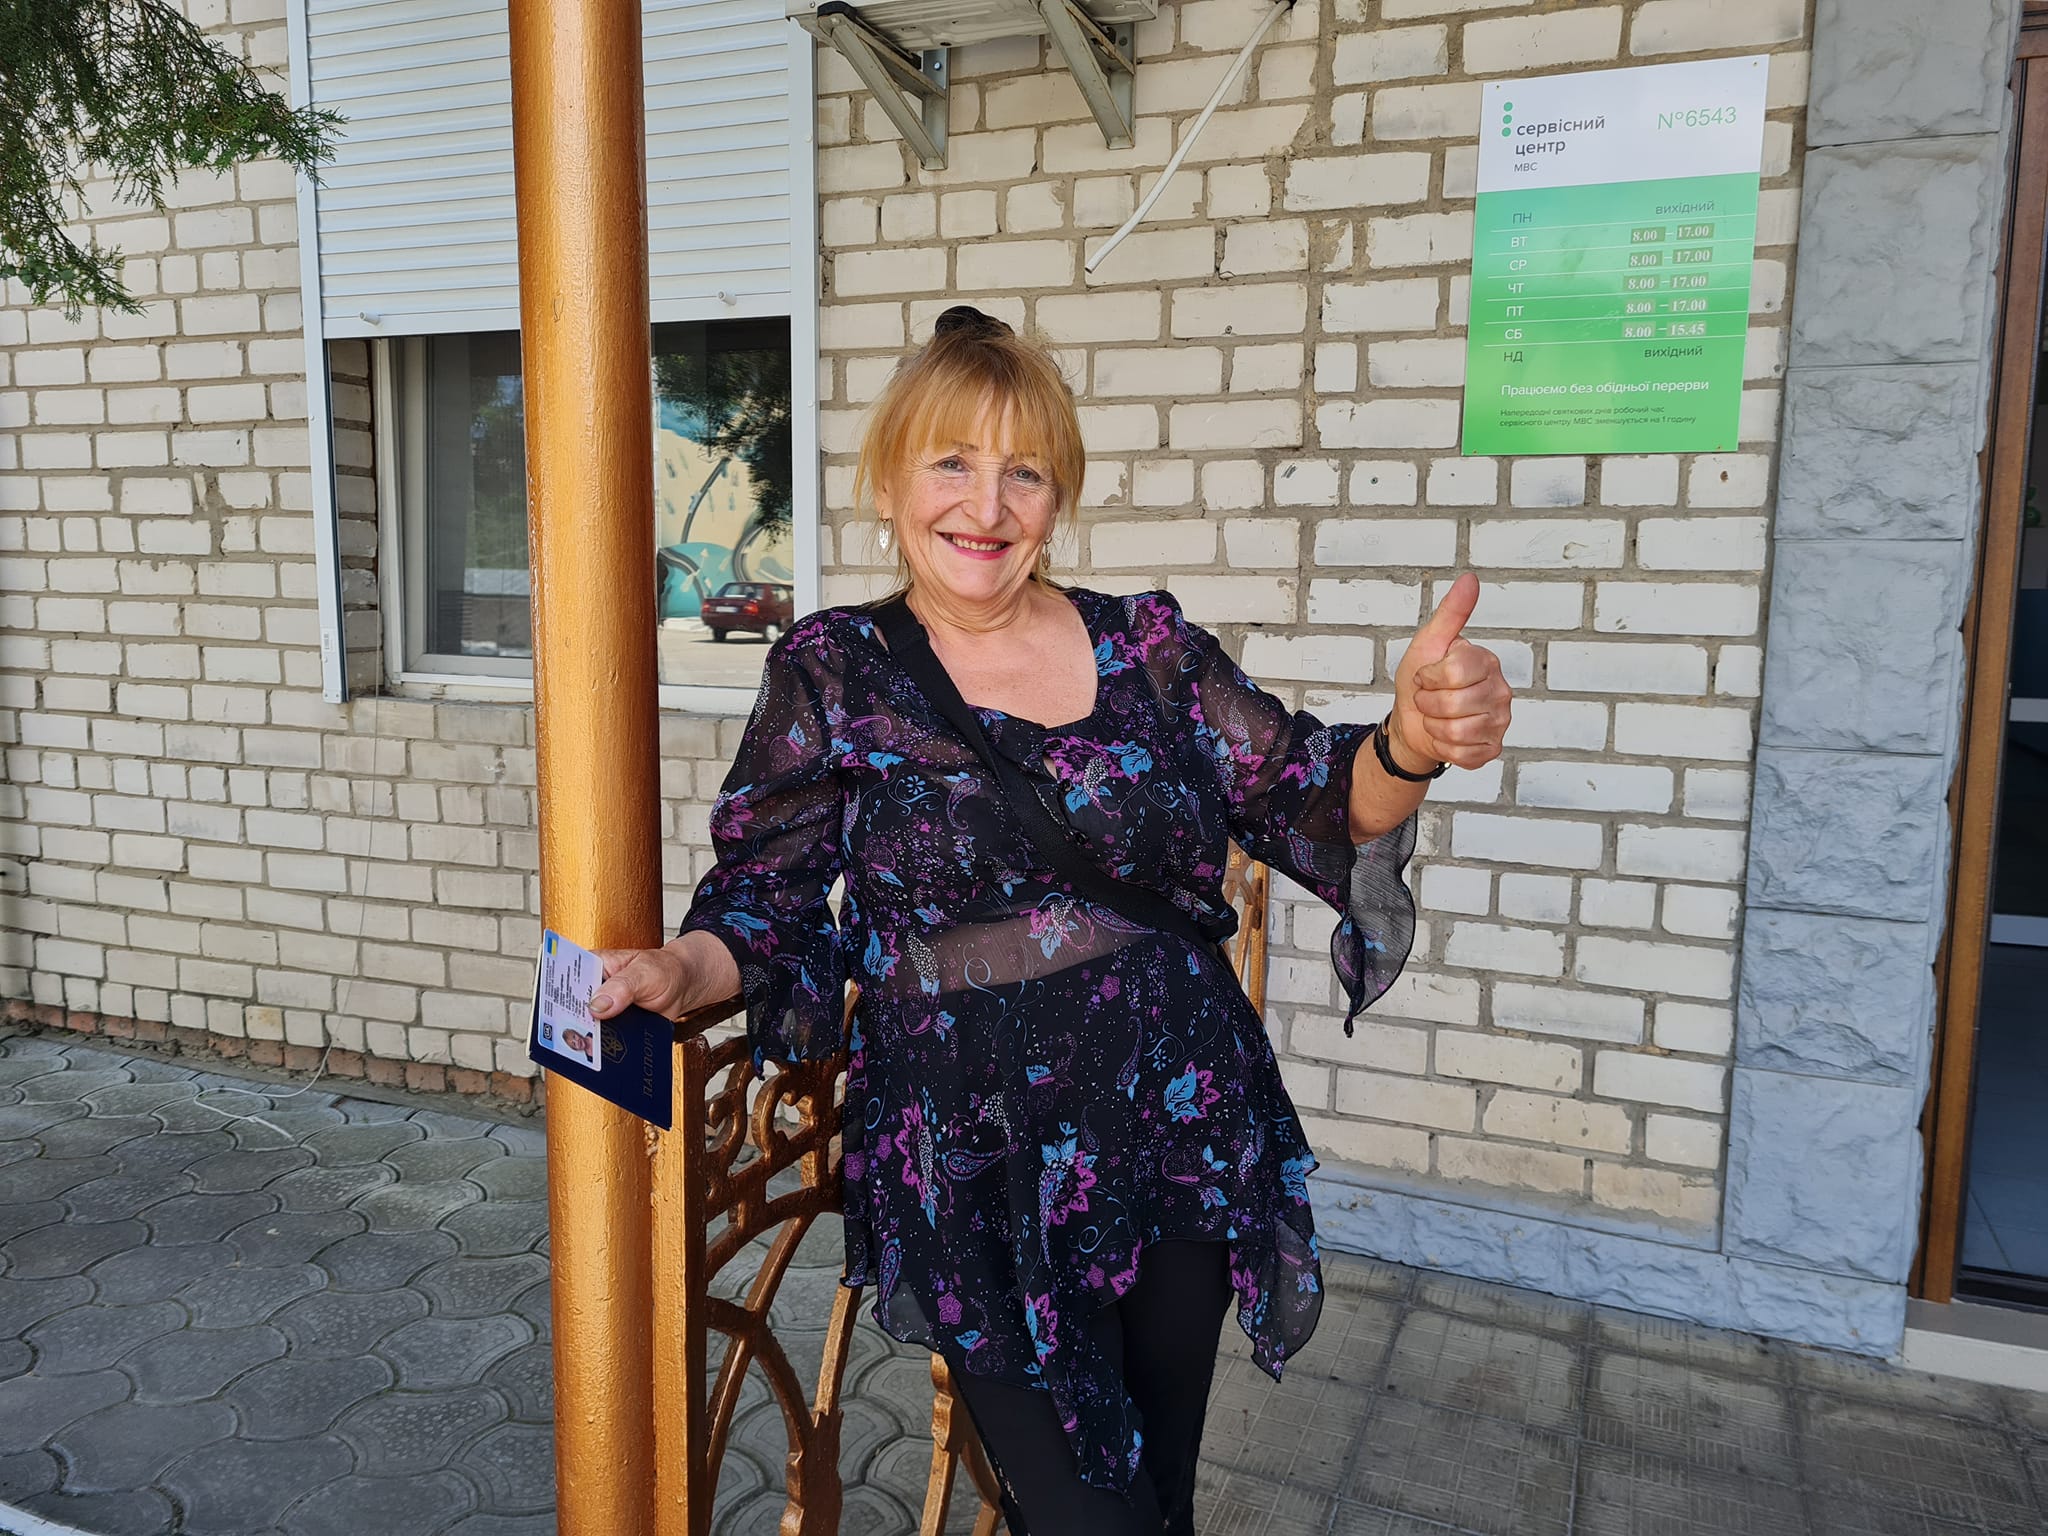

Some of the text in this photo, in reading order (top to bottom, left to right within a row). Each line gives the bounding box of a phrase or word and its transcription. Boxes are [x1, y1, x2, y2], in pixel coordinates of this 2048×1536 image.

[1517, 116, 1605, 138] сервісний
[1515, 140, 1566, 156] центр
[1513, 162, 1538, 172] МВС
[1512, 200, 1715, 225] ПН вихідний
[1511, 236, 1528, 248] ВТ
[1632, 230, 1658, 242] 8.00
[1677, 225, 1709, 238] 17.00
[1509, 260, 1528, 271] СР
[1630, 254, 1657, 266] 8.00
[1675, 249, 1710, 262] 17.00
[1507, 282, 1525, 294] ЧТ
[1627, 277, 1655, 290] 8.00
[1671, 275, 1706, 288] 17.00
[1506, 305, 1524, 317] ПТ
[1626, 302, 1652, 314] 8.00
[1671, 299, 1707, 311] 17.00
[1504, 328, 1523, 340] СБ
[1624, 326, 1652, 338] 8.00
[1670, 323, 1705, 336] 15.45
[1503, 345, 1703, 363] НД вихідний
[1501, 380, 1710, 397] Працюємо без обідньої перерви
[1572, 417, 1593, 425] МВС
[643, 1029, 656, 1099] ПАСПОРТ
